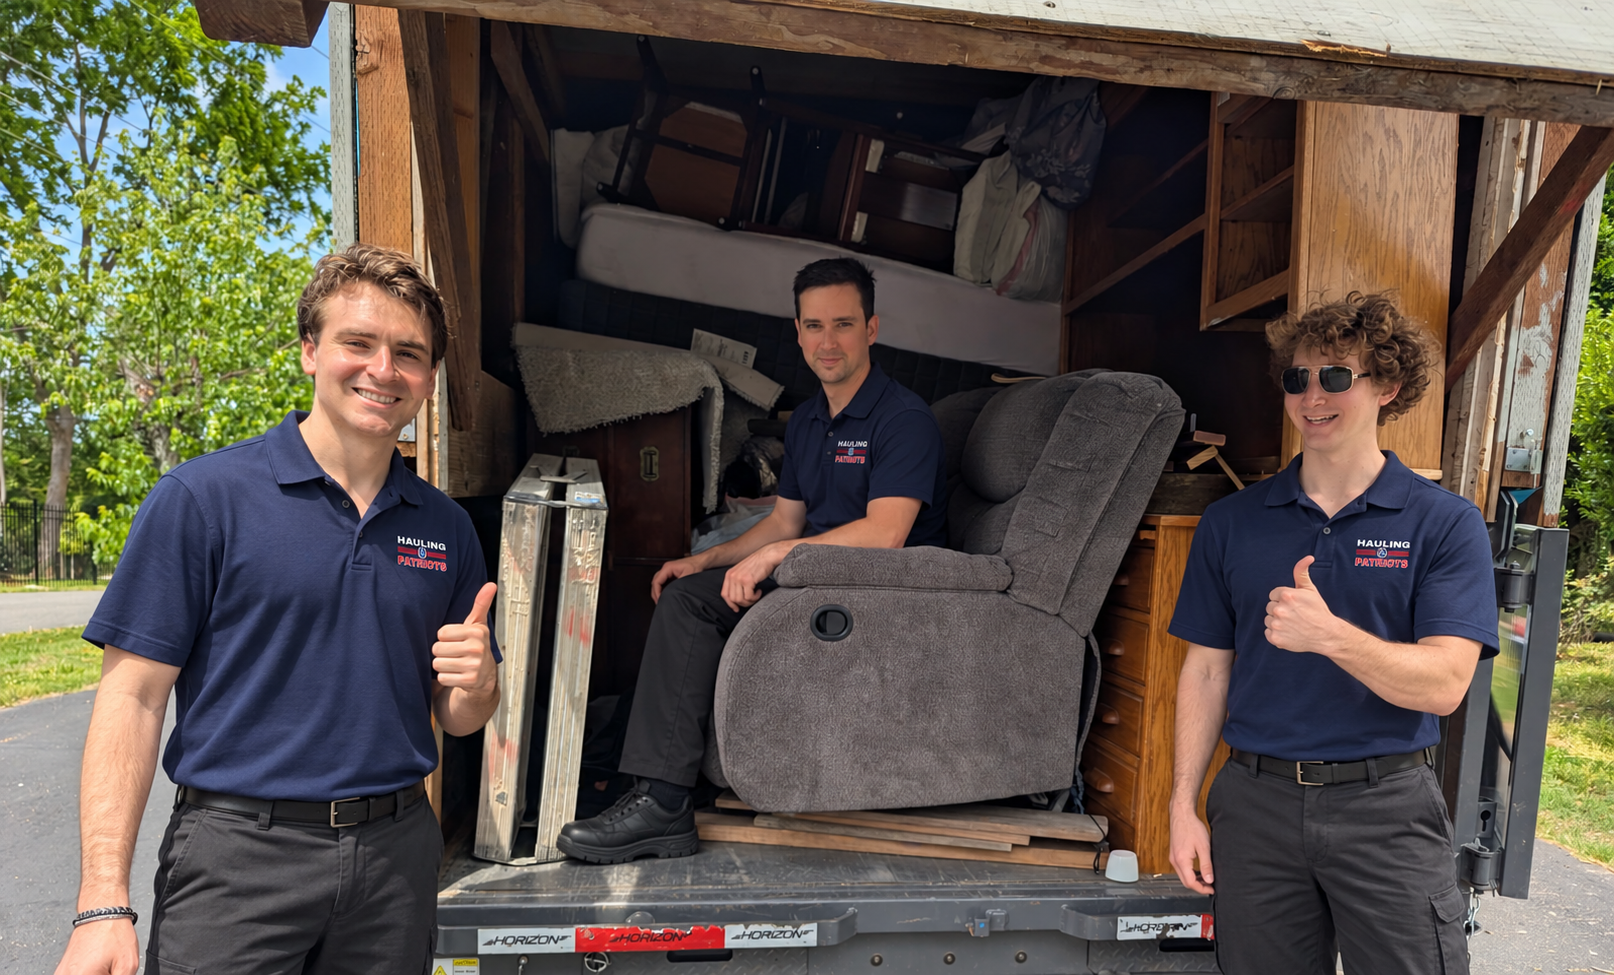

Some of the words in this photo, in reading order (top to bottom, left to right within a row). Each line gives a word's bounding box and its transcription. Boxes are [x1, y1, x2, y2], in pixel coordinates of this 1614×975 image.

[397, 535, 446, 551] HAULING
[1357, 539, 1411, 549] HAULING
[397, 555, 447, 572] PATRIOTS
[1354, 557, 1409, 569] PATRIOTS
[492, 934, 561, 945] HORIZON
[617, 931, 684, 943] HORIZON
[740, 930, 804, 940] HORIZON
